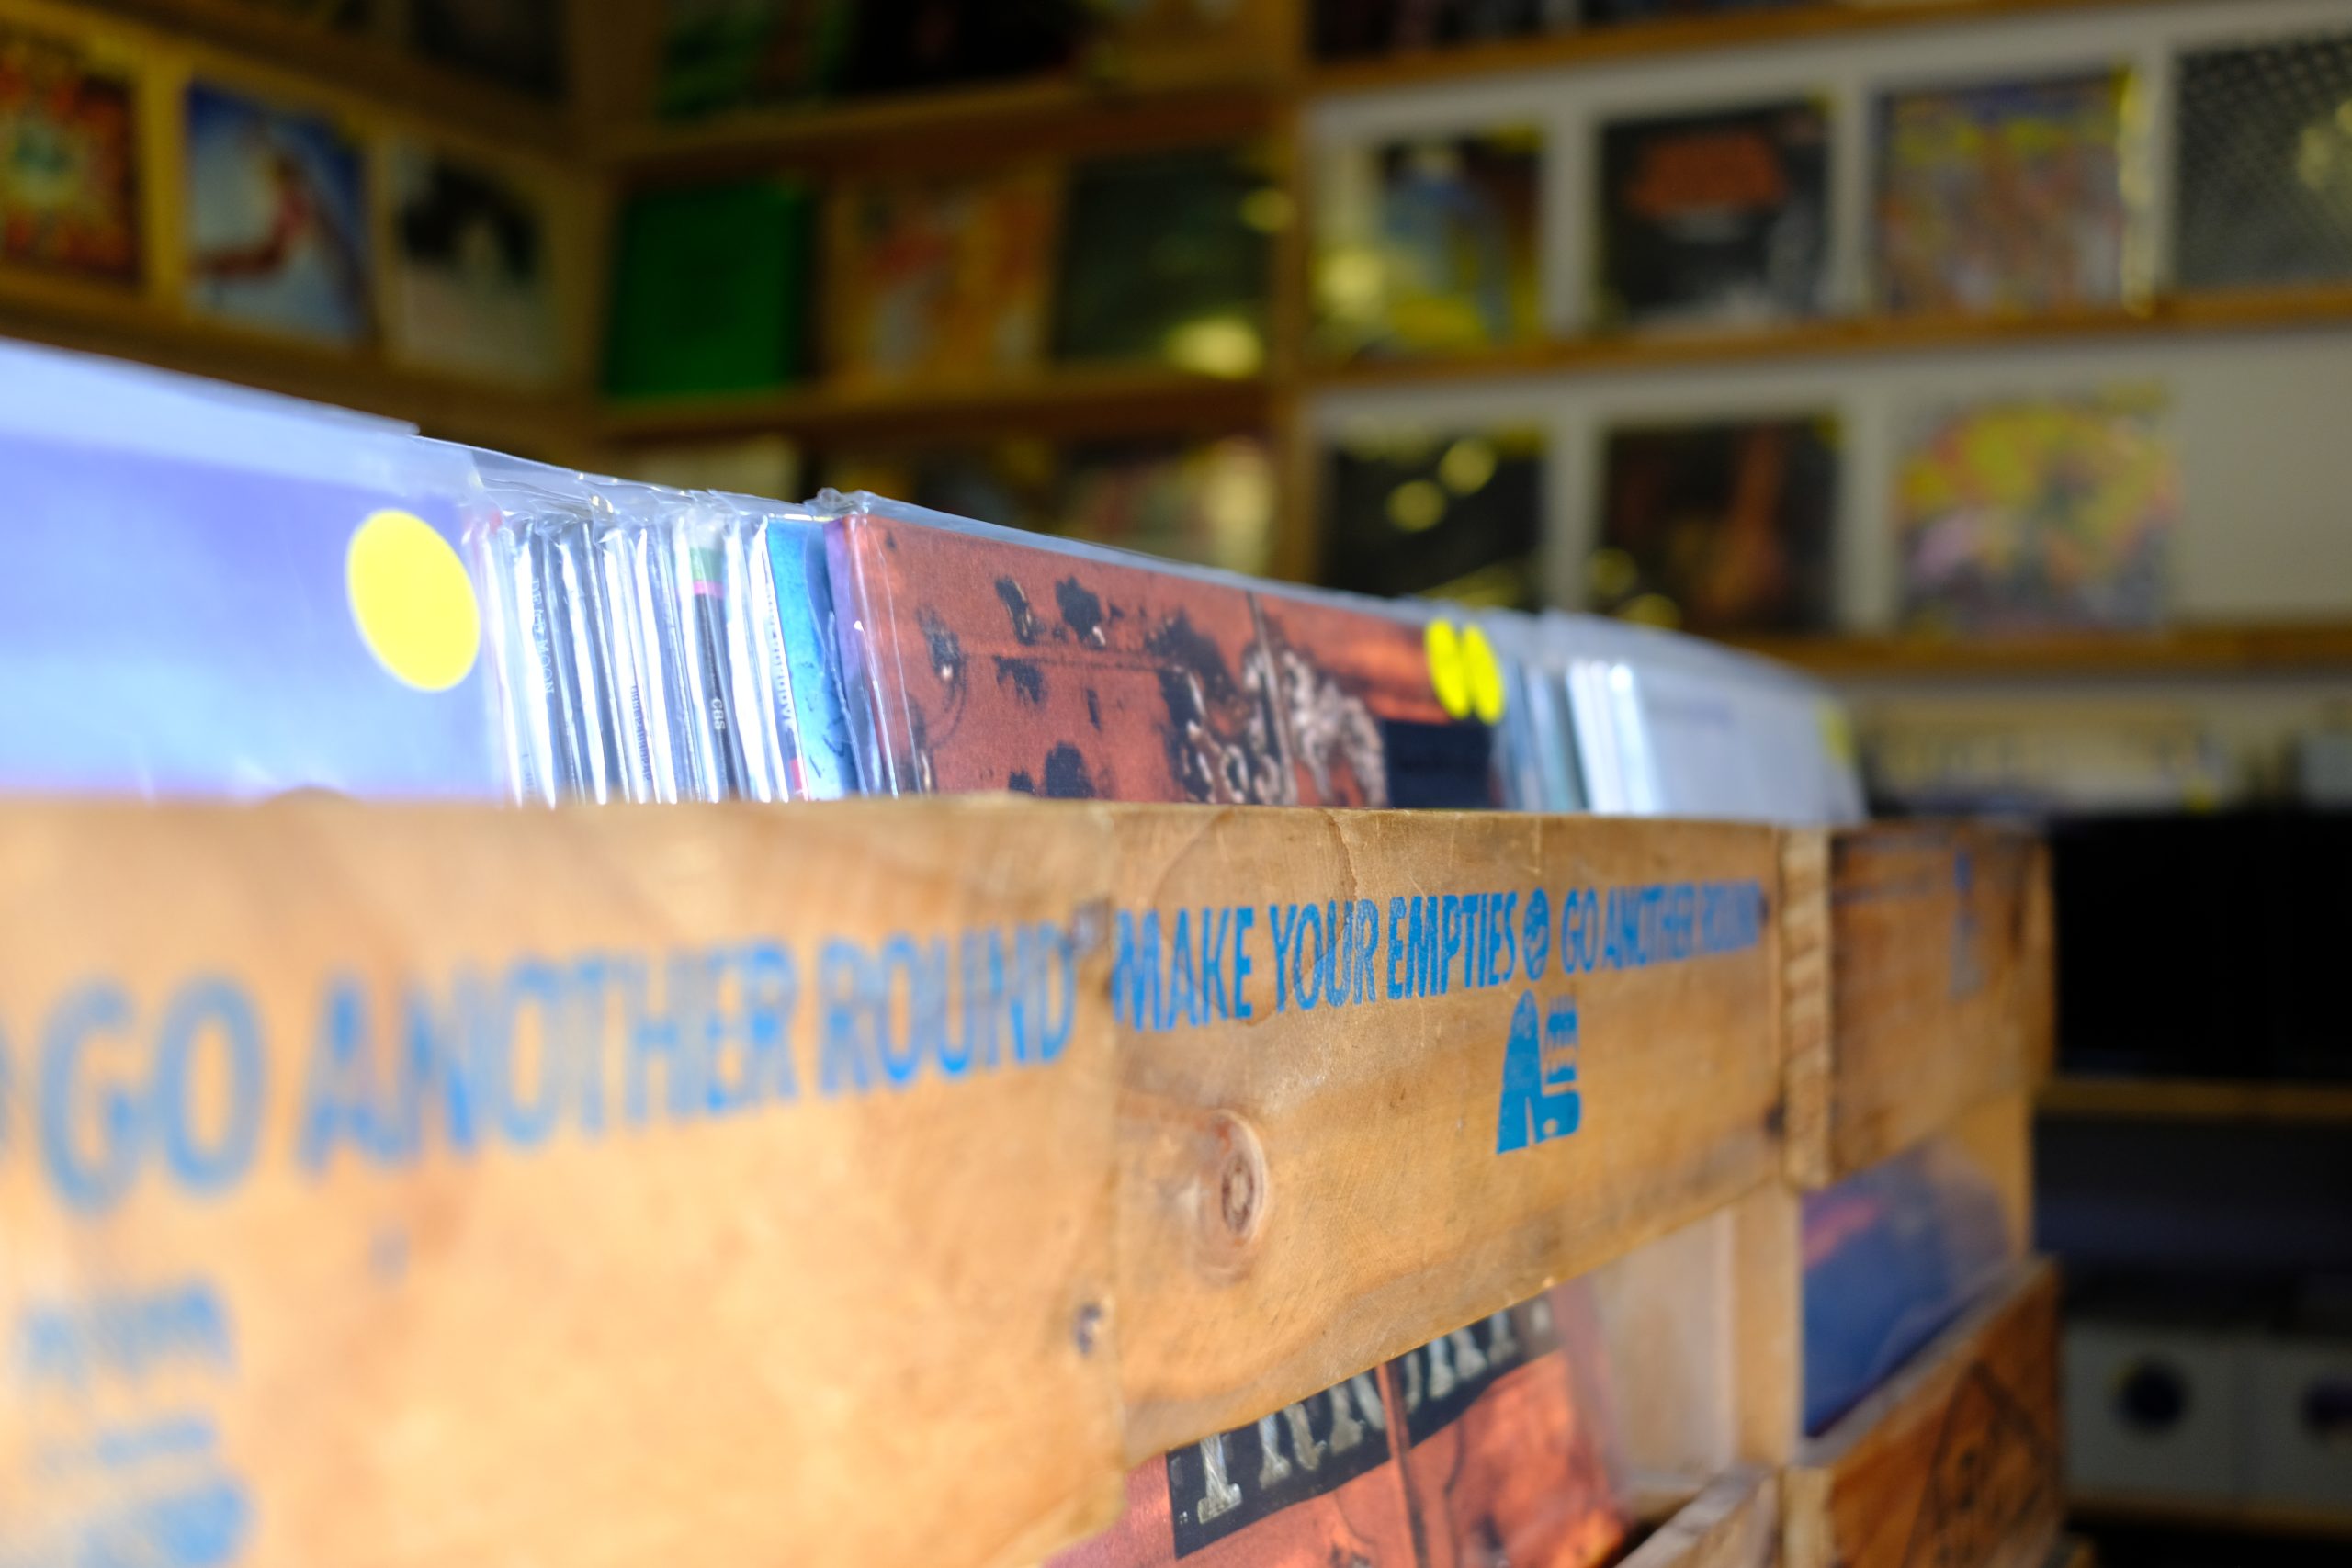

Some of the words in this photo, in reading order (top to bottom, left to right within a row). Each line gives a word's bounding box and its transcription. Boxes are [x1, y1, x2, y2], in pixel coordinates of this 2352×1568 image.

[537, 638, 556, 694] MOON
[712, 697, 726, 730] CBS
[1111, 906, 1254, 1032] MAKE
[1268, 897, 1381, 1014] YOUR
[1386, 889, 1519, 1001] EMPTIES
[1560, 886, 1600, 976] GO
[37, 974, 267, 1217] GO
[292, 937, 801, 1185] ANOTHER
[818, 920, 1077, 1093] ROUND
